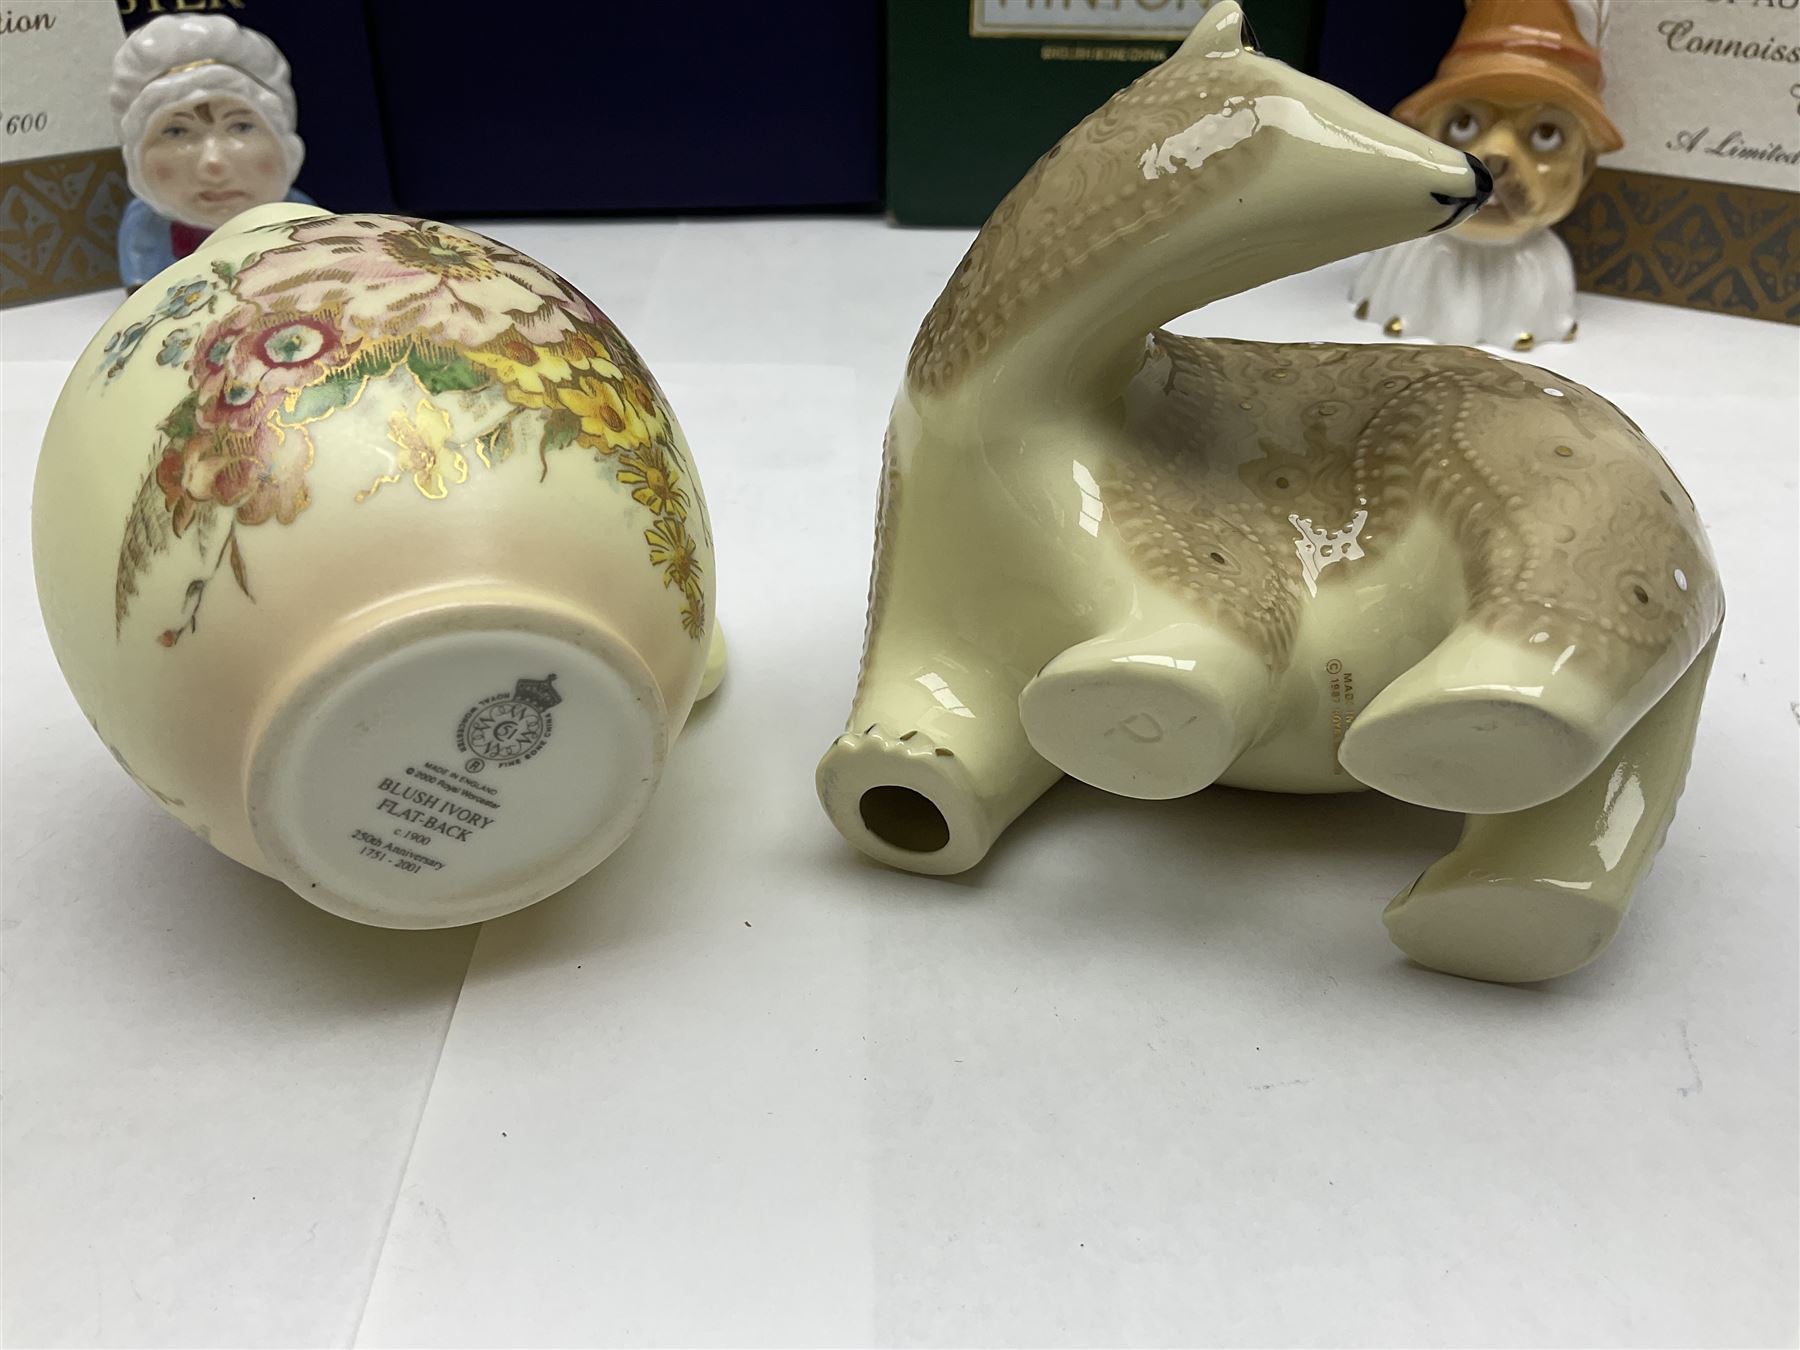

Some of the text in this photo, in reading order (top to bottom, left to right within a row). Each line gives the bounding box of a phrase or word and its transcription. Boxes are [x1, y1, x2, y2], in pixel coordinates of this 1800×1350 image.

[0, 10, 56, 34] ion
[6, 112, 47, 136] 600
[1665, 126, 1709, 152] A
[456, 692, 510, 753] ROYAL WORCESTER
[498, 712, 552, 768] FINE BONE CHINA
[414, 771, 437, 784] 2000
[437, 779, 460, 794] Royal
[461, 789, 501, 809] Worcester
[424, 761, 498, 796] MADE IN ENGLAND
[376, 798, 473, 842] FLAT-BACK
[377, 777, 494, 830] BLUSH IVORY
[351, 829, 446, 871] 250th Anniversary
[359, 846, 386, 861] 1751
[394, 858, 421, 874] 2001
